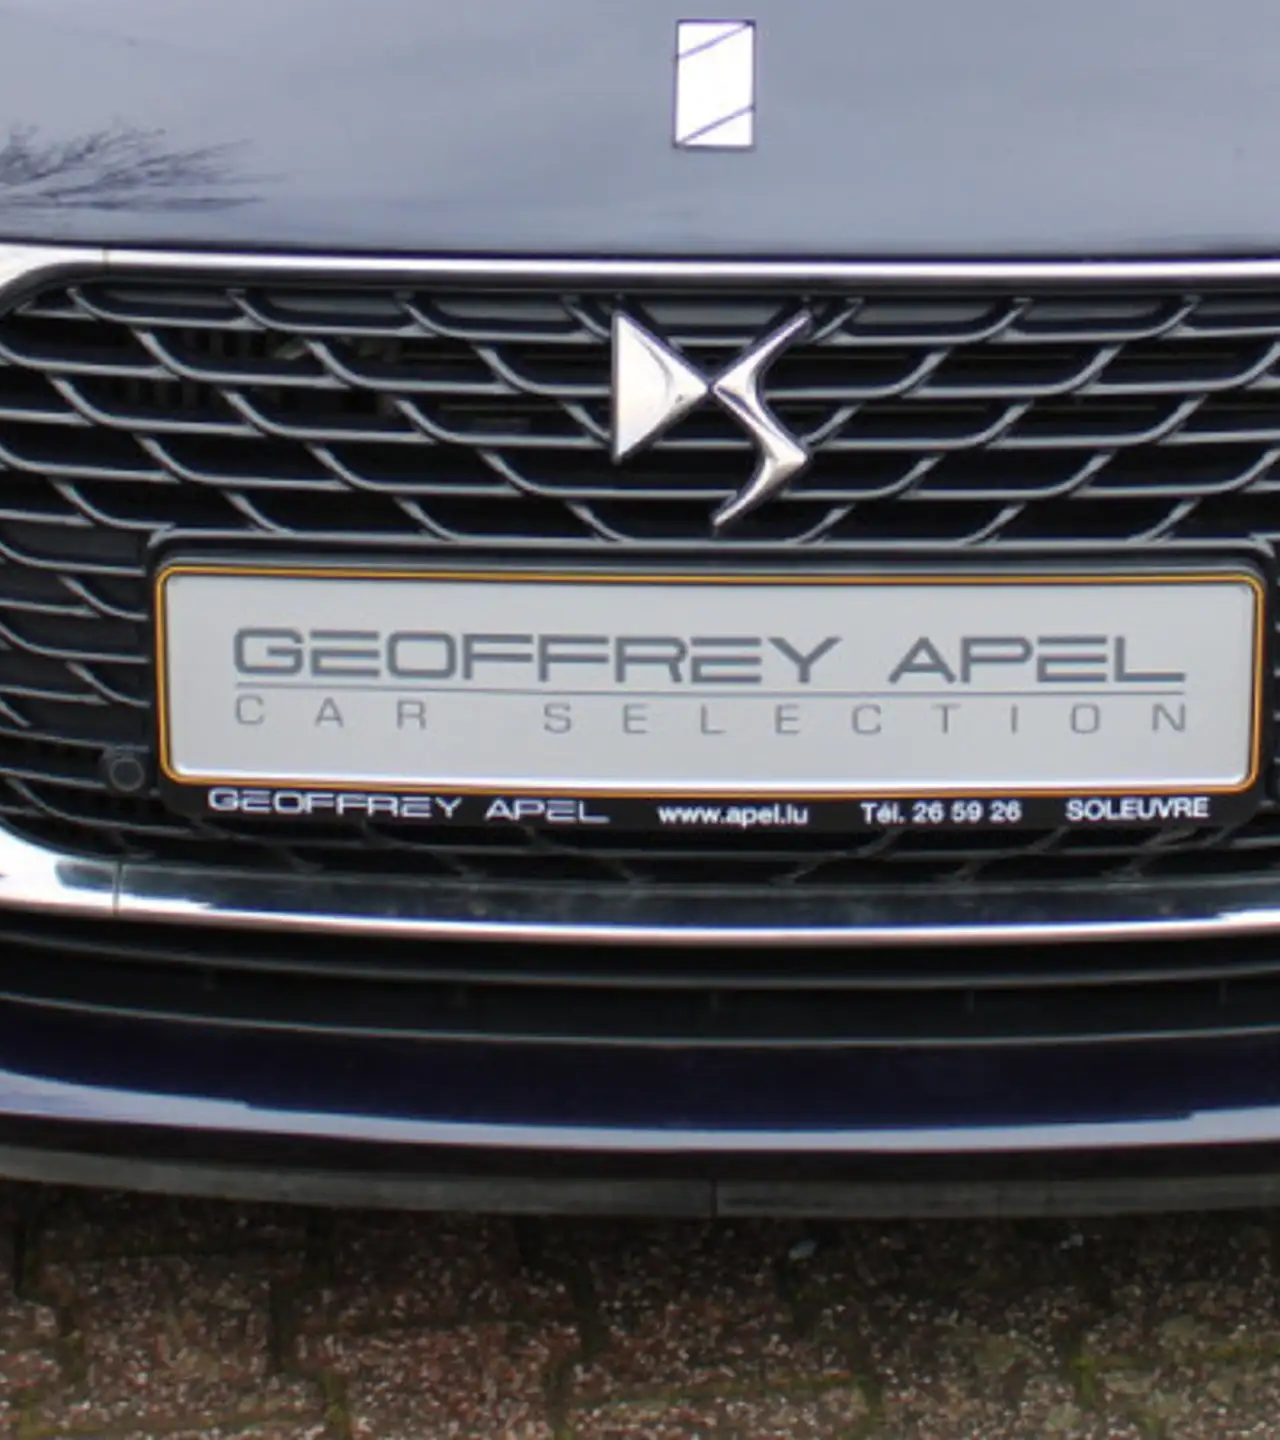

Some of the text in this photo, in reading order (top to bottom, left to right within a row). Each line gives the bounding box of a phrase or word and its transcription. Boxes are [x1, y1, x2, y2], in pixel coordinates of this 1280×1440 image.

[233, 627, 1186, 684] GEOFFREY APEL
[234, 693, 1187, 735] CAR SELECTION
[207, 786, 1211, 829] GEOFFREY APEL www.apel.lu Tél. 26 59 26 SOLEUVRE
